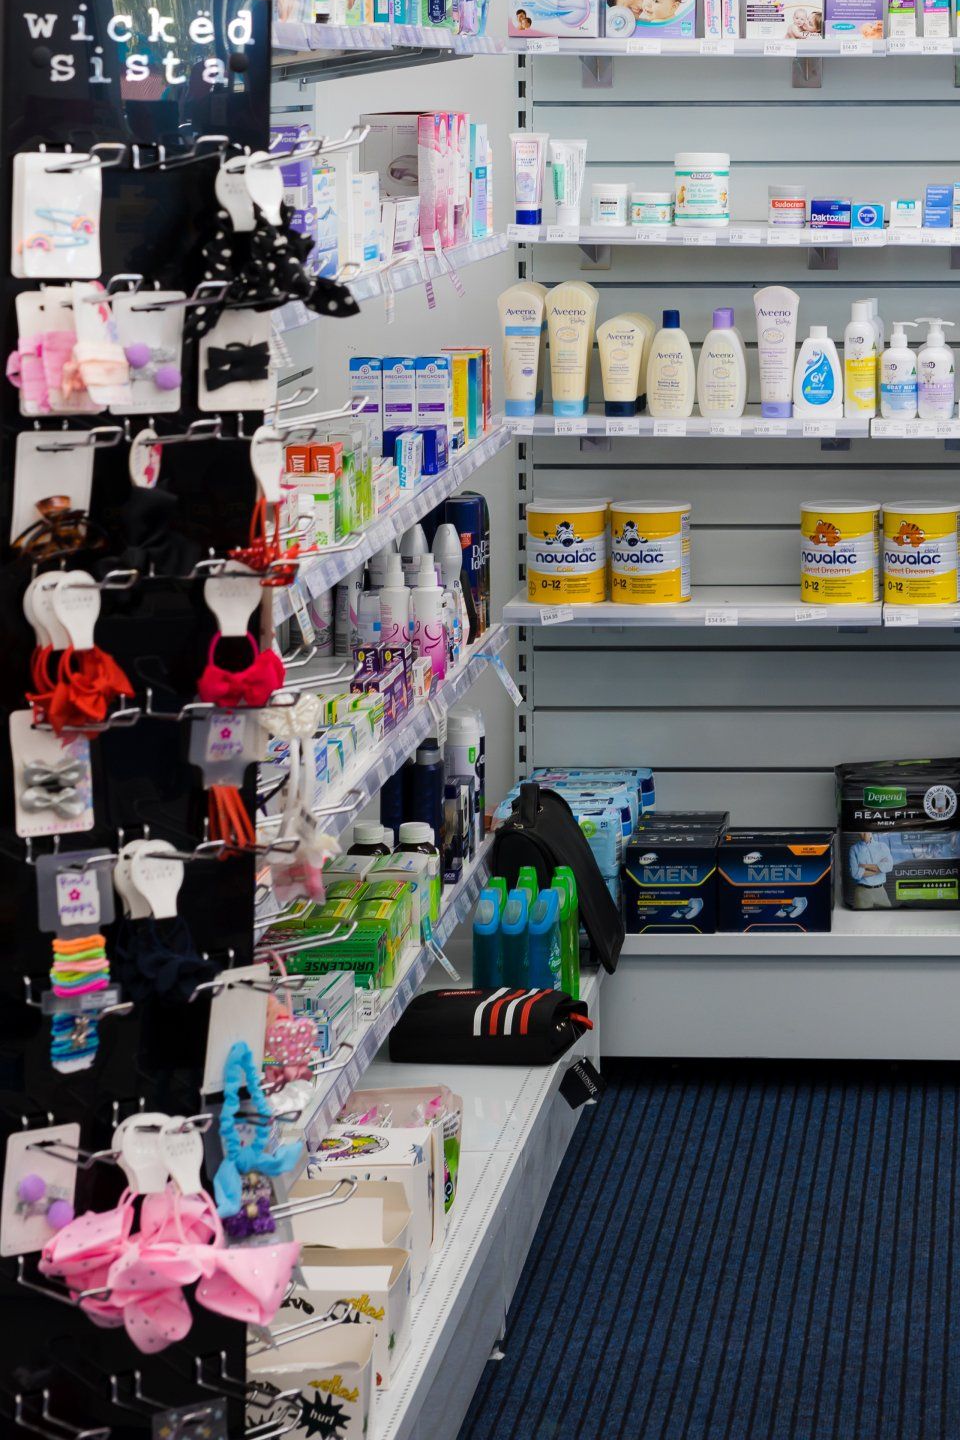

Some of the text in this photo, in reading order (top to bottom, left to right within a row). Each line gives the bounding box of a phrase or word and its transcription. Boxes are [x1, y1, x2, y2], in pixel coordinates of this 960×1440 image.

[50, 47, 229, 85] sista
[505, 308, 536, 316] Aveeno
[550, 308, 586, 316] Aveeno
[757, 309, 791, 317] Aveeno
[811, 372, 825, 382] QV
[535, 550, 597, 565] novalac
[610, 550, 664, 564] novalac
[801, 550, 857, 565] novalac
[885, 551, 941, 565] novalac
[541, 580, 561, 589] 0-12
[613, 579, 627, 588] 0-12
[804, 581, 820, 591] 0-12
[888, 581, 903, 591] 0-12
[868, 792, 903, 803] Depend
[854, 811, 917, 819] REAL FIT
[643, 869, 698, 882] MEN
[748, 868, 802, 881] MEN
[894, 869, 959, 877] UNDERWEAR
[303, 961, 375, 972] URICLENSE
[573, 1063, 600, 1095] WINDSOR
[309, 1409, 335, 1426] hurl
